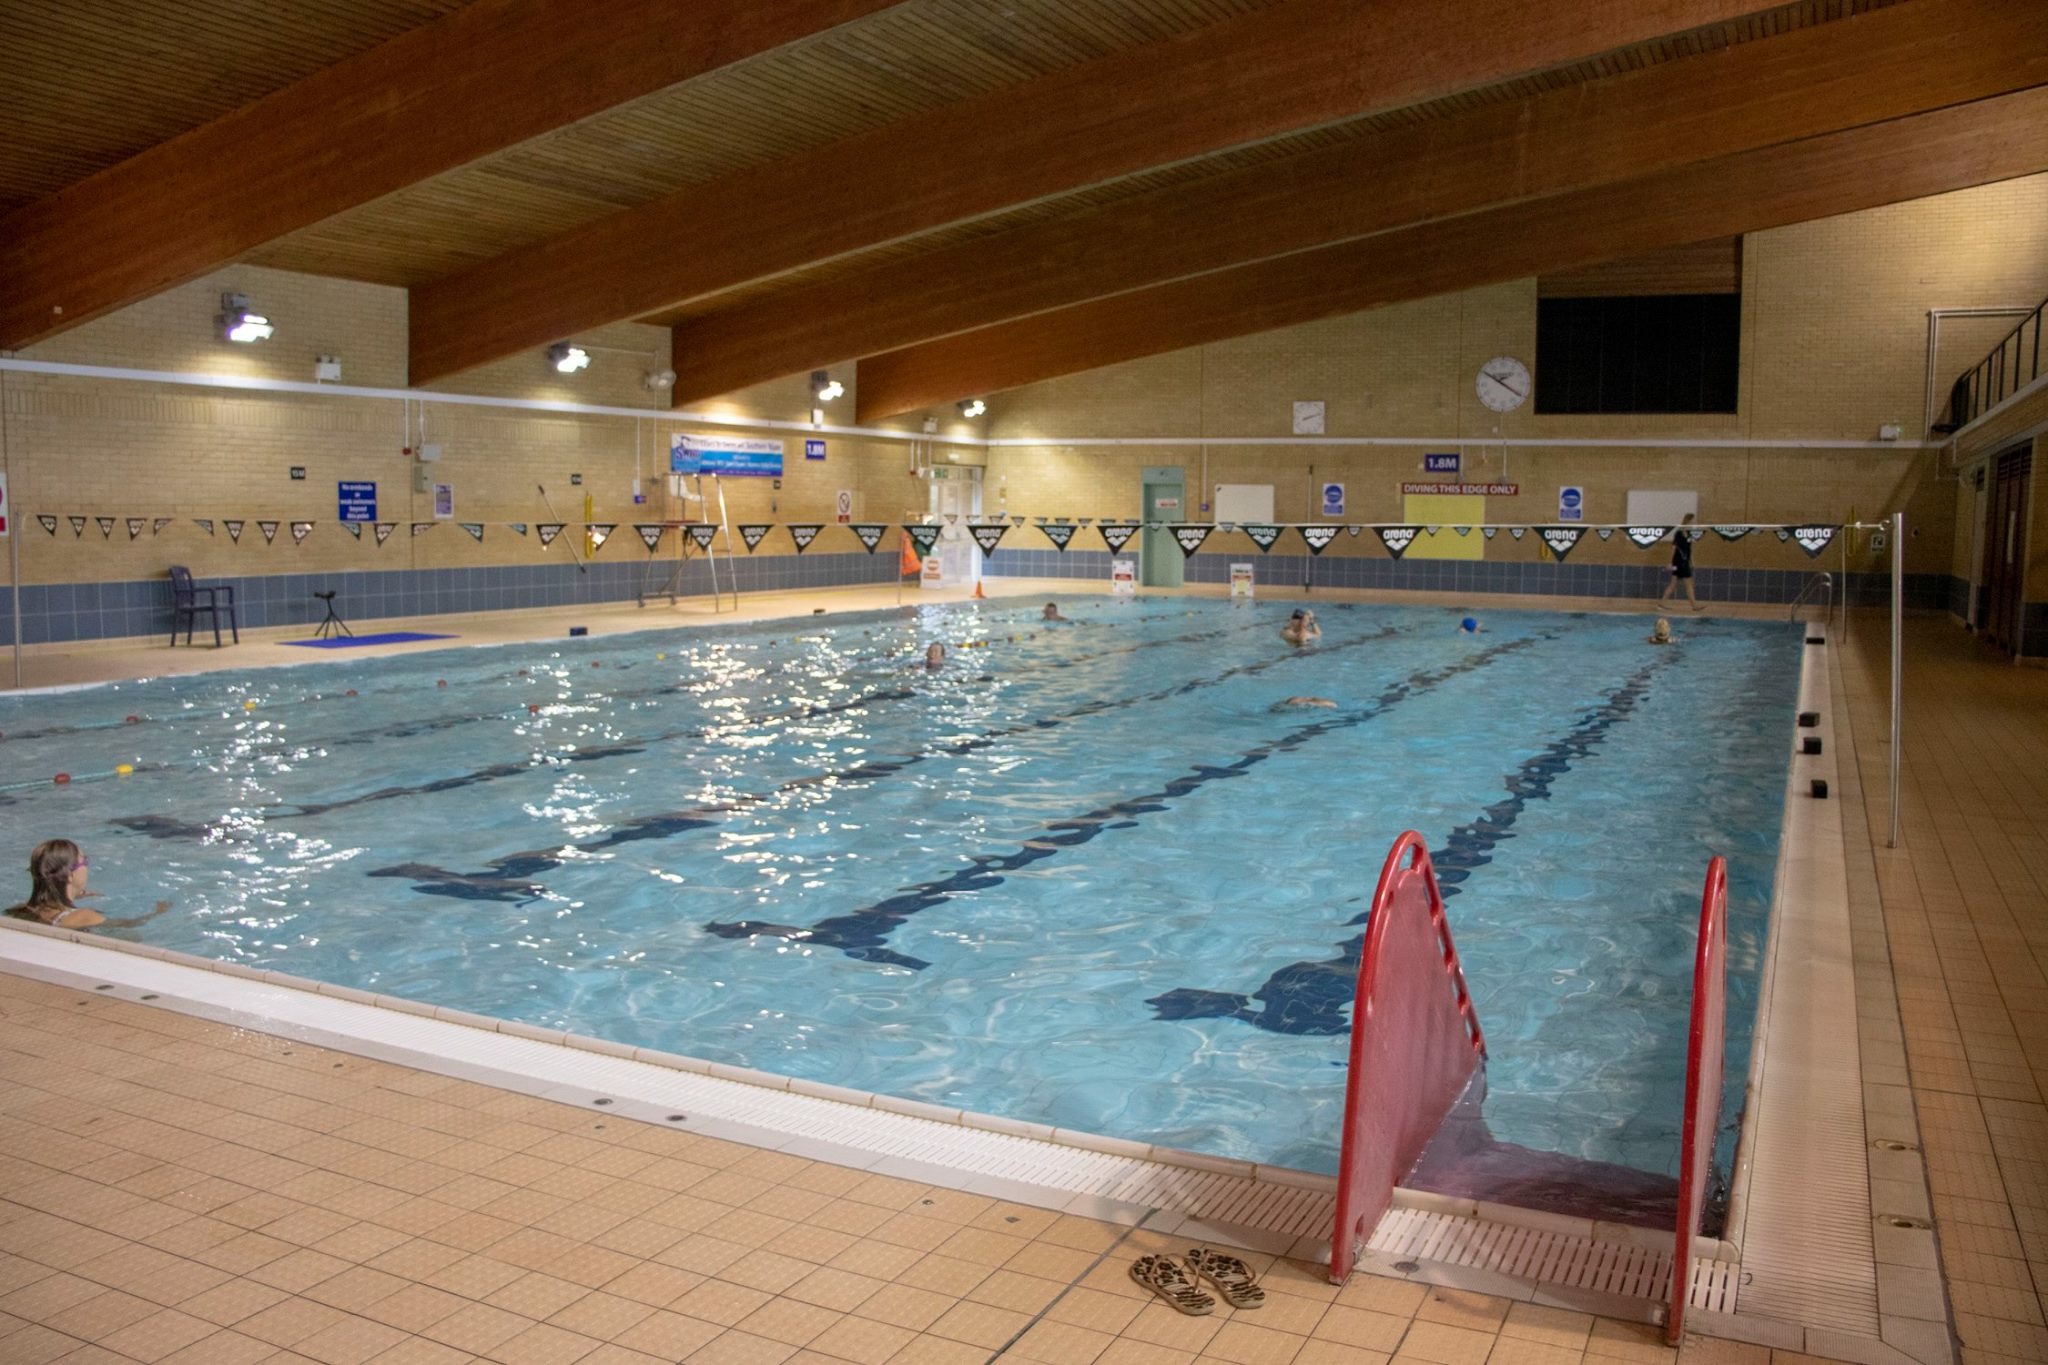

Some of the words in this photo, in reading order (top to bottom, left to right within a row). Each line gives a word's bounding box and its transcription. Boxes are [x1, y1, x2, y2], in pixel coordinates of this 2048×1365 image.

[1428, 458, 1457, 469] 1.8M
[1404, 484, 1438, 494] DIVING
[1439, 485, 1460, 494] THIS
[1462, 485, 1488, 494] EDGE
[1490, 485, 1516, 495] ONLY
[1105, 527, 1132, 537] arena
[1177, 528, 1206, 539] arena
[1248, 527, 1277, 537] arena
[1304, 527, 1335, 538] arena
[1383, 528, 1414, 539] arena
[1544, 529, 1578, 541] arena
[1629, 527, 1664, 537] arena
[1795, 528, 1832, 538] arena
